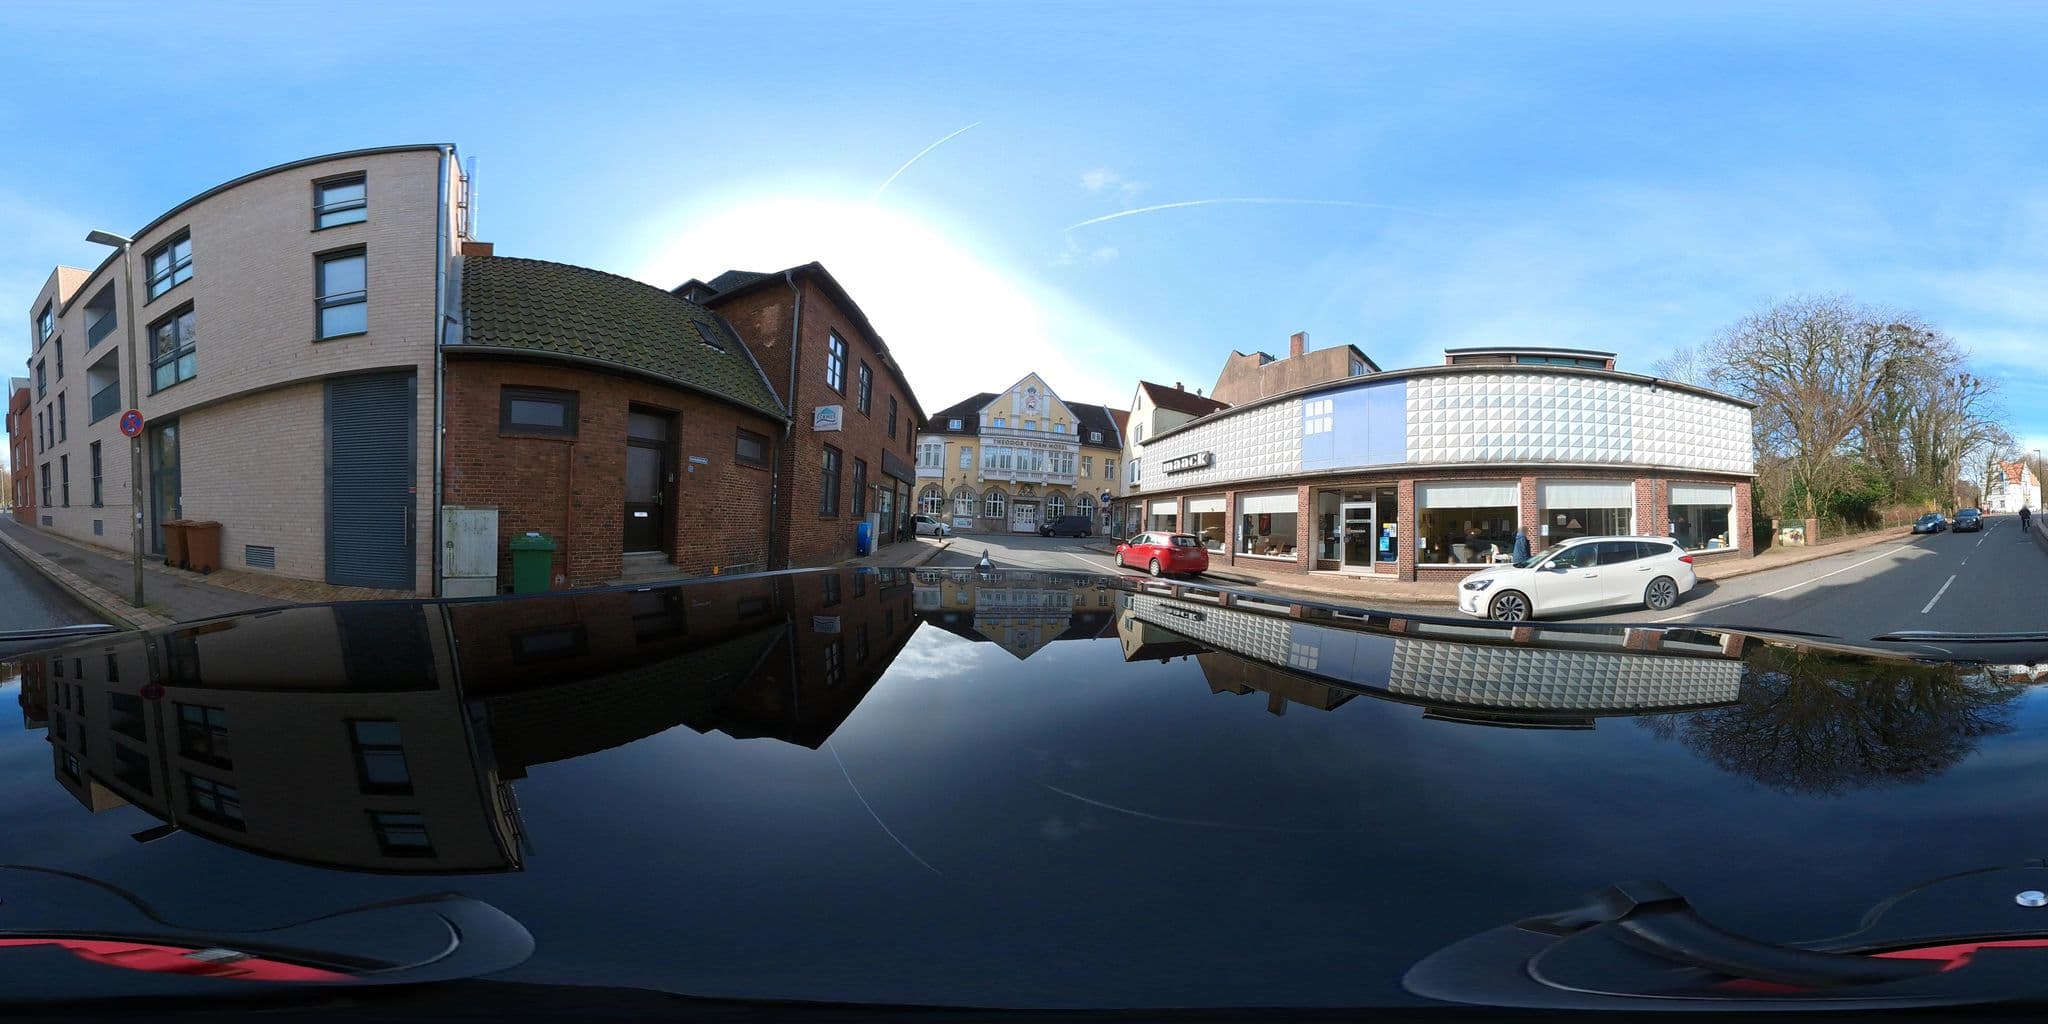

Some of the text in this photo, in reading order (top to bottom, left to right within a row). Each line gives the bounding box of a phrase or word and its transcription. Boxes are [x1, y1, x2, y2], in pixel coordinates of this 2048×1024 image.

[993, 439, 1068, 450] THEODOR STORM HOTEL
[1163, 453, 1207, 472] maack
